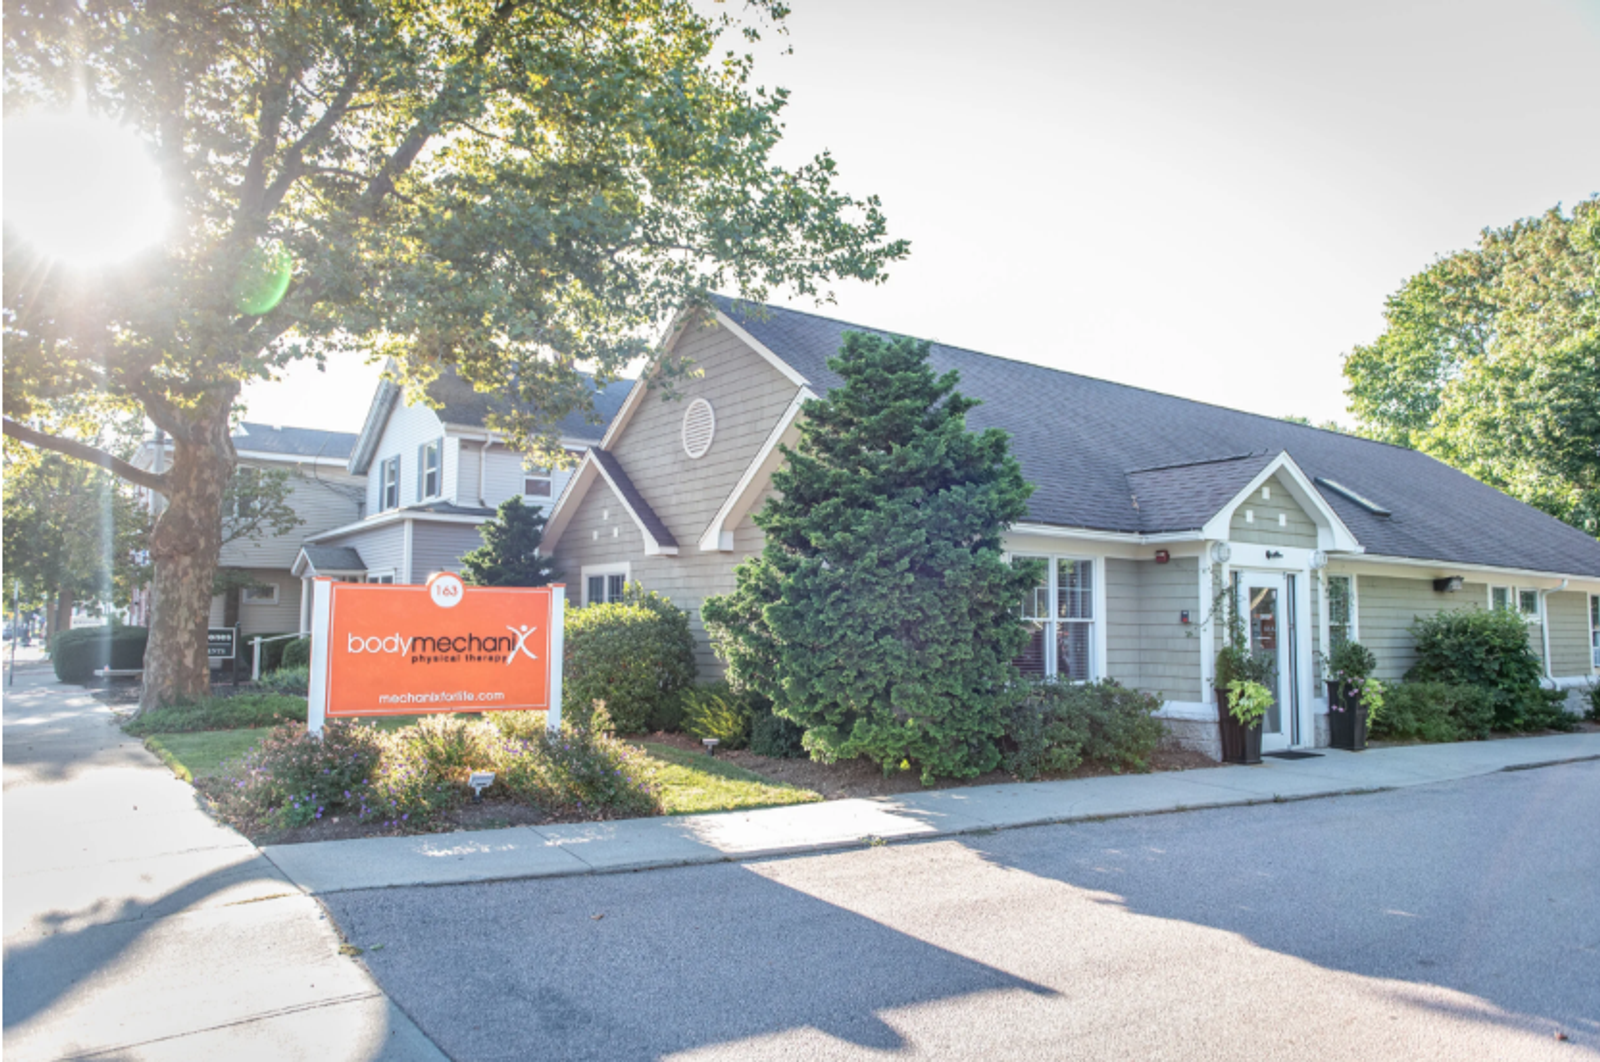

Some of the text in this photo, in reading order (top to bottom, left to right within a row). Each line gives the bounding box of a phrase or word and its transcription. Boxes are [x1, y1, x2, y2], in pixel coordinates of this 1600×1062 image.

[435, 585, 458, 597] 163
[411, 653, 508, 665] physical therapy
[378, 690, 505, 704] mechanixforlife.com
